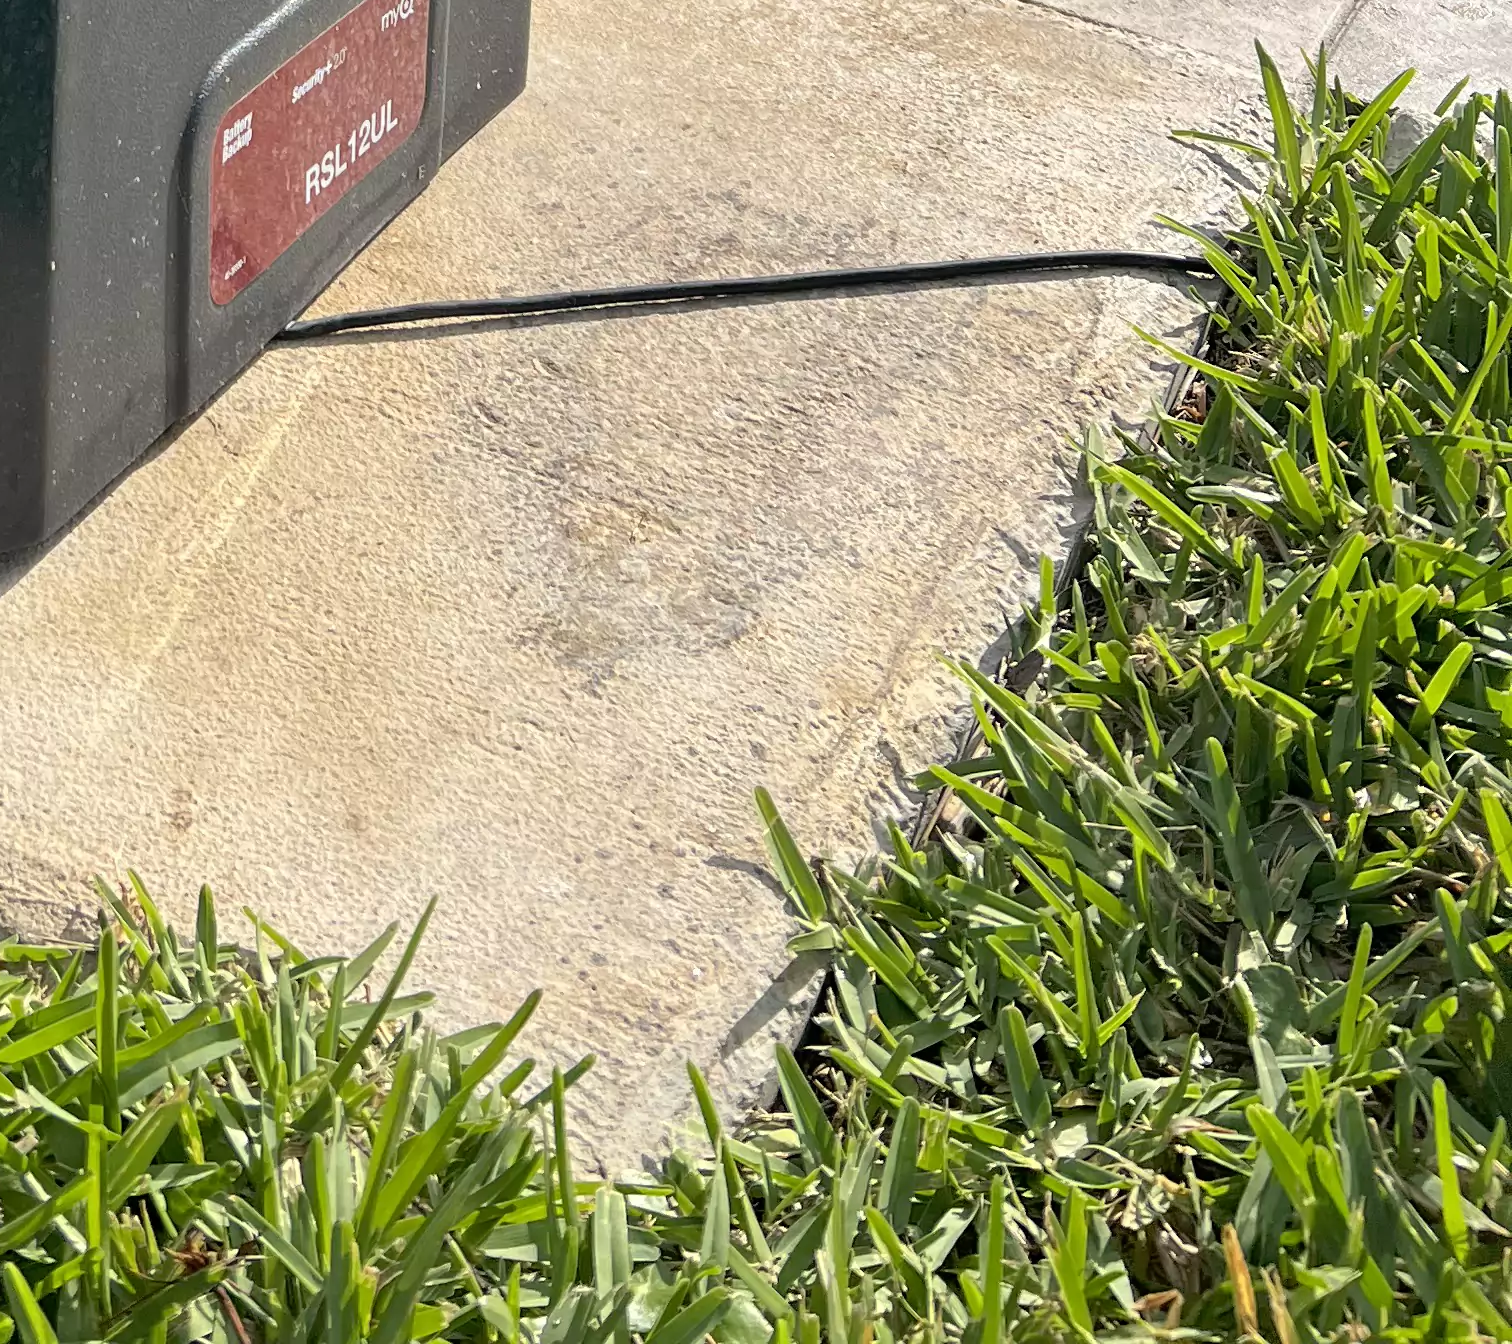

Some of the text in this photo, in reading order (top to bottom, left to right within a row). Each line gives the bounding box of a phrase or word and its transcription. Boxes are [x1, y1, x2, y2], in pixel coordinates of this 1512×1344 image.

[222, 128, 252, 165] Backup
[224, 112, 252, 146] Battery
[305, 99, 398, 204] RSL12UL
